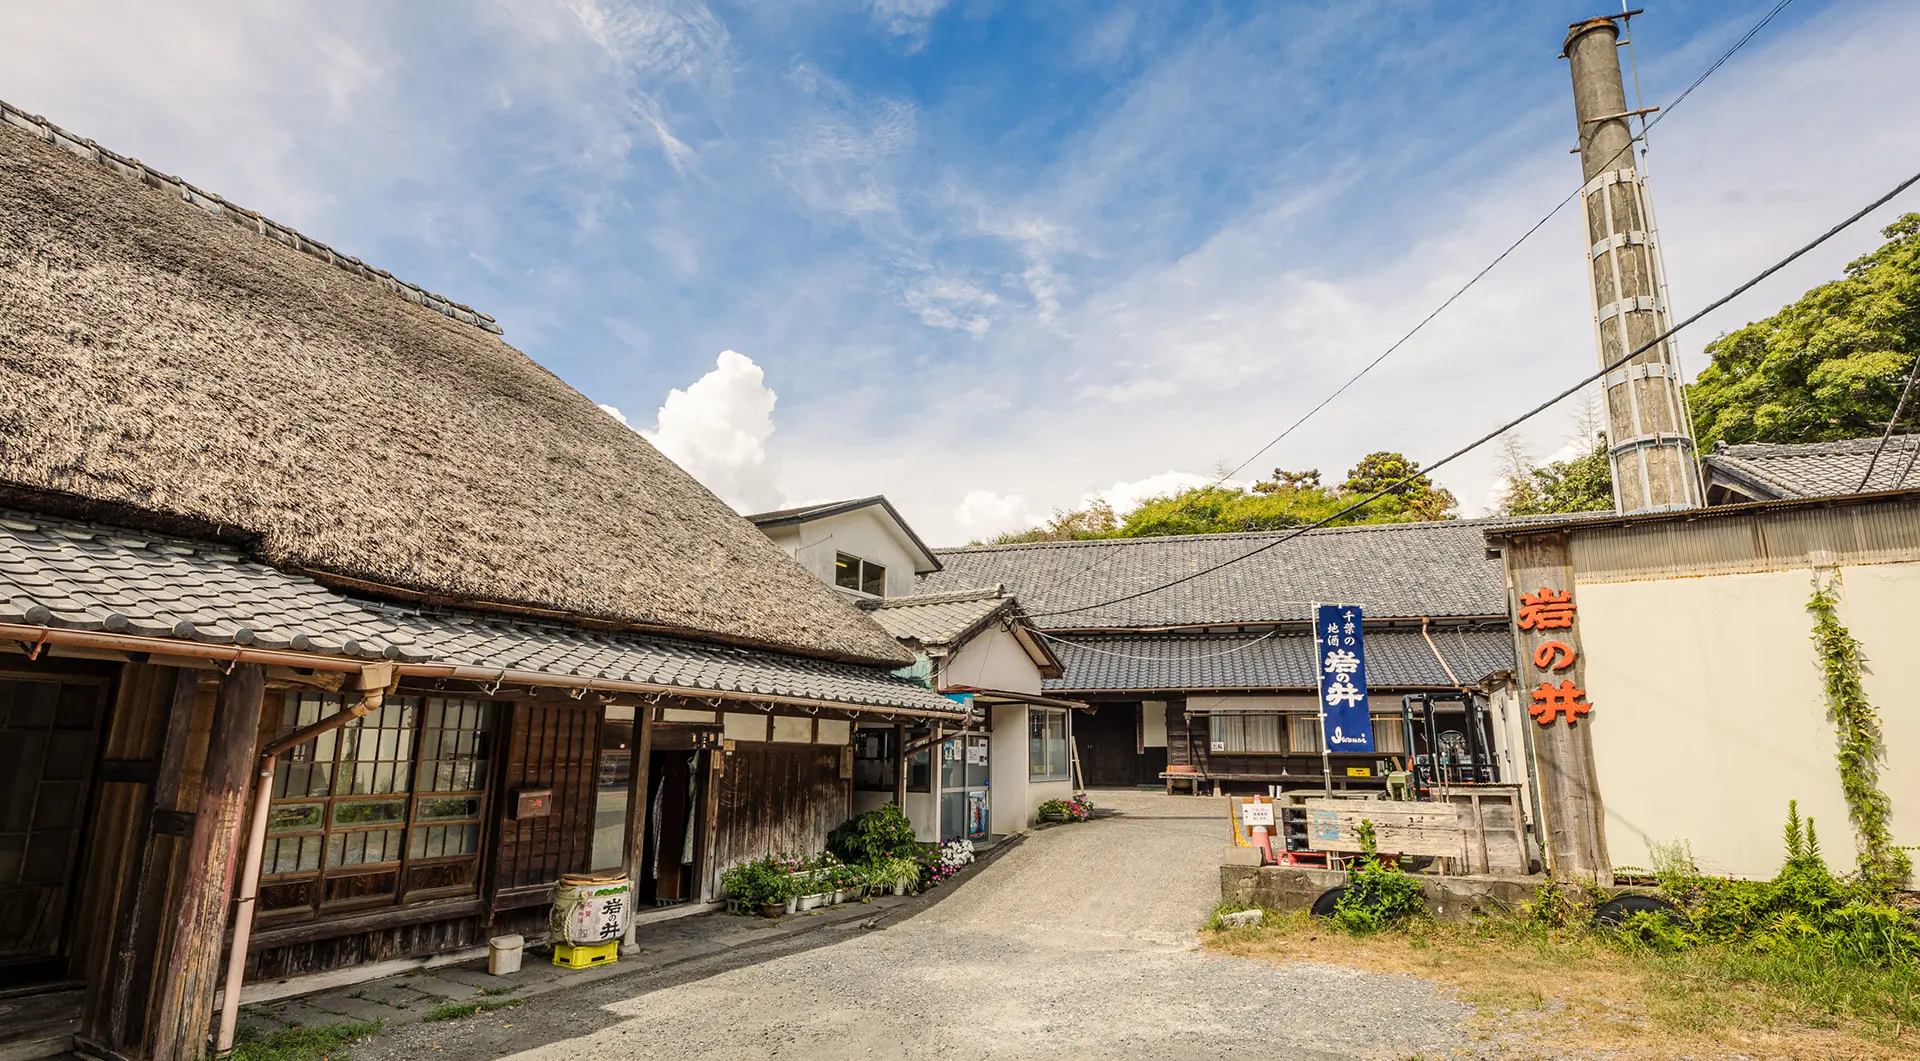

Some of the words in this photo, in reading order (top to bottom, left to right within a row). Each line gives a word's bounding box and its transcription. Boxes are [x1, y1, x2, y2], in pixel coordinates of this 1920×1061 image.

[1327, 622, 1340, 647] 地酒
[1342, 610, 1356, 646] 千葉の
[1517, 587, 1594, 725] 岩の井
[1324, 648, 1365, 708] 岩の井
[599, 898, 623, 940] 岩の井
